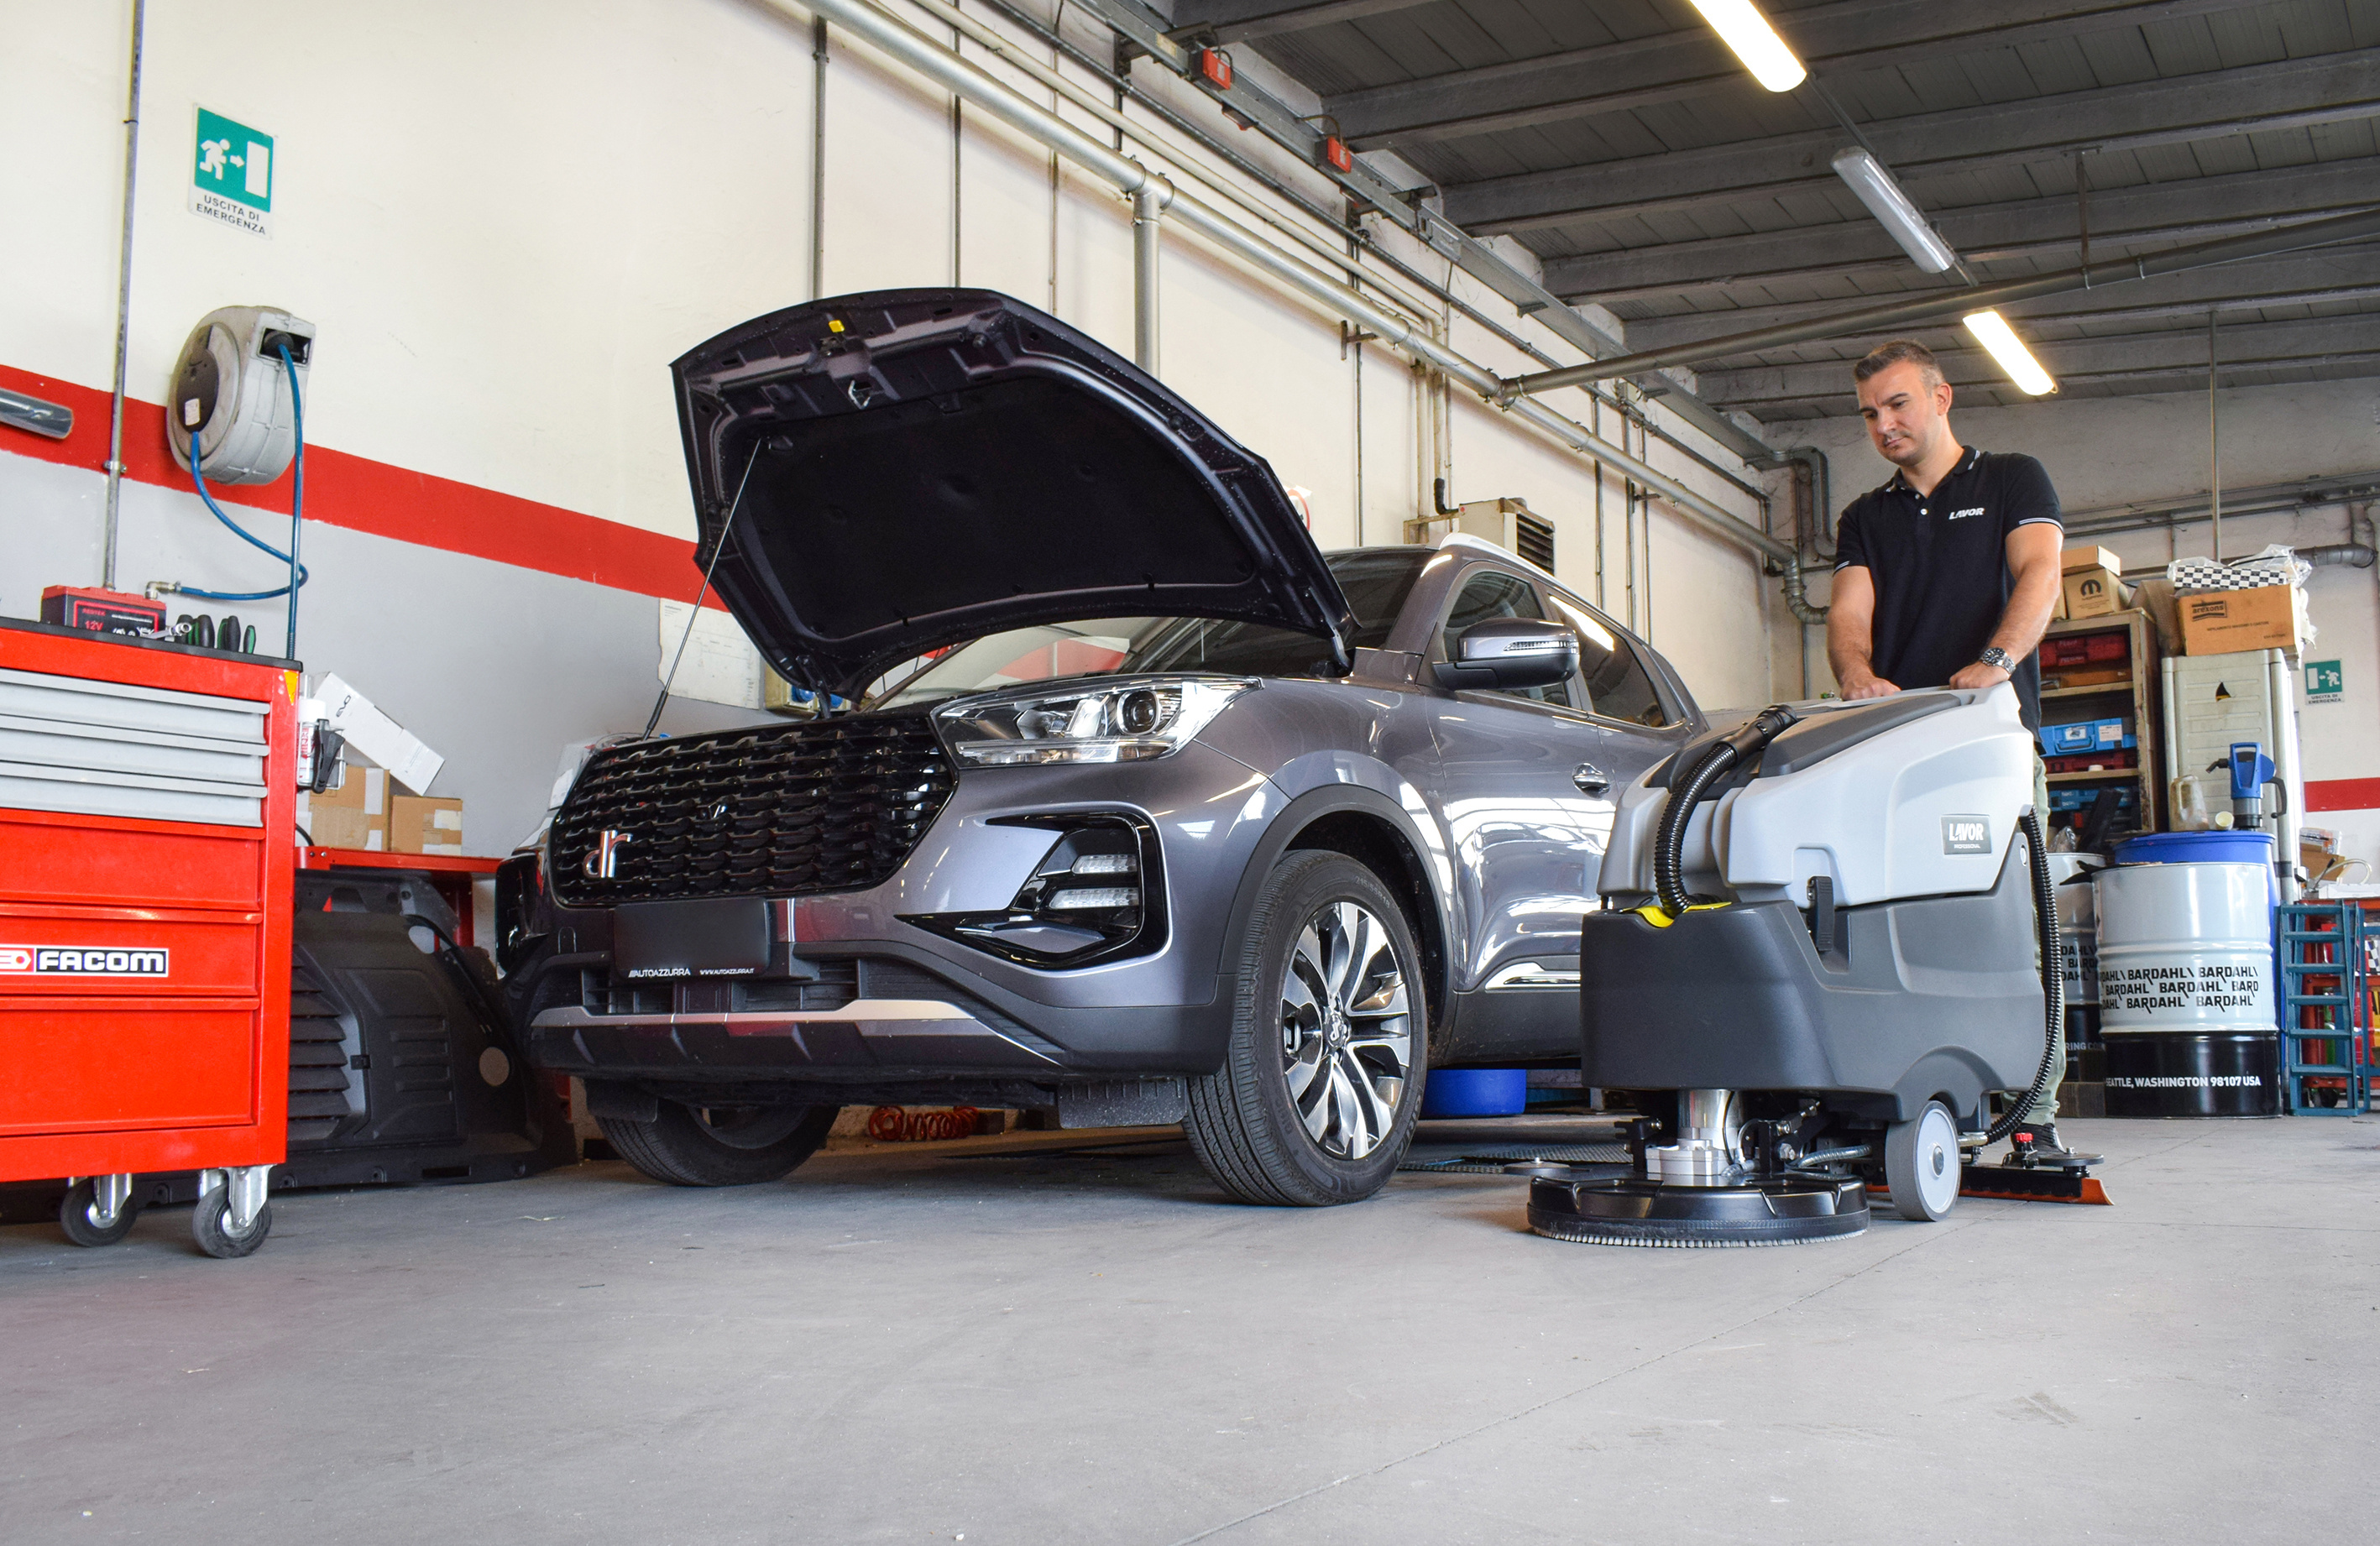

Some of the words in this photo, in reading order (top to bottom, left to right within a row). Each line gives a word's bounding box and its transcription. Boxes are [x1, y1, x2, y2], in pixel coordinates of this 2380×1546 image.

[204, 194, 245, 217] USCITA
[248, 211, 259, 222] DI
[196, 202, 266, 234] EMERGENZA
[1948, 507, 1985, 520] LAVOR
[2192, 604, 2224, 614] arexons
[85, 619, 104, 631] 12V
[336, 695, 352, 718] EVO
[1948, 823, 1984, 841] LAVOR
[39, 950, 165, 972] FACOM
[2127, 968, 2187, 985] BARDAHL
[2199, 966, 2253, 984] BARDAHL
[2105, 983, 2150, 1000] BARDAHL
[2159, 980, 2223, 999] BARDAHL
[2126, 996, 2186, 1014] BARDAHL
[2196, 995, 2253, 1012] BARDAHL
[2105, 1078, 2135, 1089] SEATTLE,
[2134, 1076, 2209, 1088] WASHINGTON
[2210, 1075, 2242, 1087] 98107
[2242, 1075, 2262, 1086] USA
